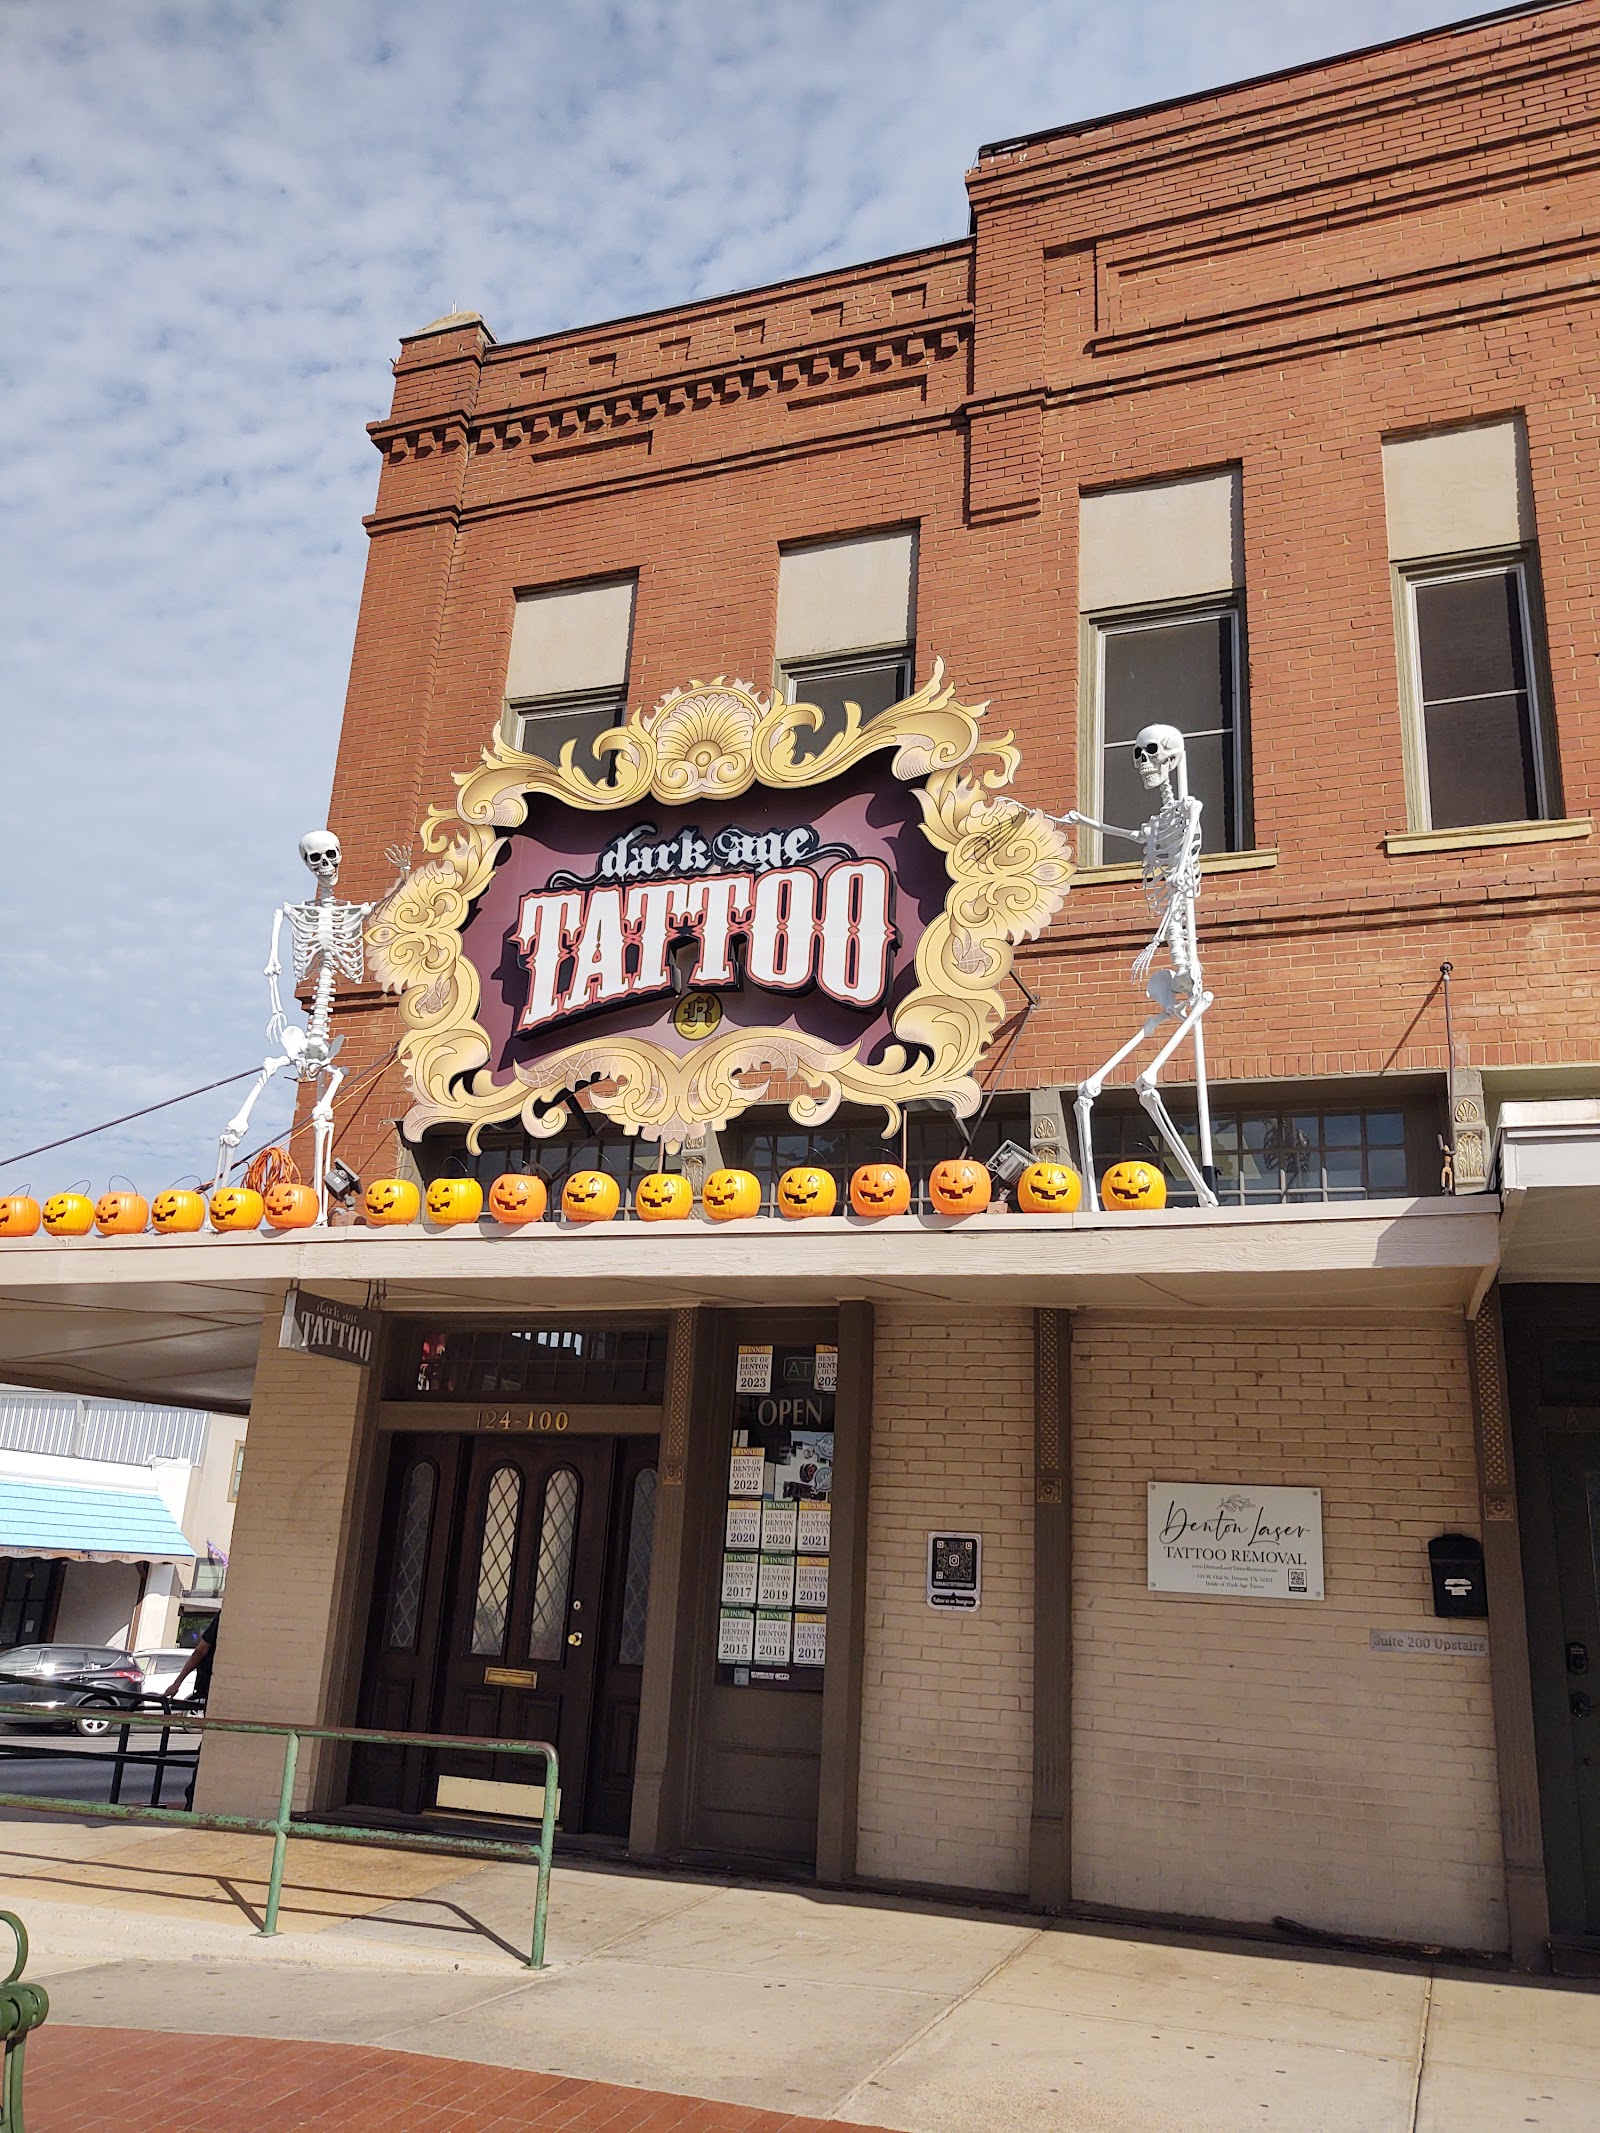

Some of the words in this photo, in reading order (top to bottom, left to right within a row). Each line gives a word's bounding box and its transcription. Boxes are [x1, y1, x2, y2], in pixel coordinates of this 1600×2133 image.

[601, 824, 708, 878] dark
[713, 826, 812, 871] age
[508, 857, 897, 1032] TATTOO
[301, 1311, 372, 1362] TATTOO
[787, 1361, 815, 1377] AT
[740, 1378, 766, 1387] 2023
[818, 1377, 837, 1386] 202
[758, 1399, 823, 1427] OPEN
[476, 1410, 569, 1431] 124-100
[734, 1480, 758, 1489] 2022
[1159, 1500, 1248, 1544] Denton
[1248, 1507, 1310, 1546] Laser
[730, 1533, 755, 1542] 2020
[766, 1534, 790, 1544] 2020
[802, 1535, 827, 1545] 2021
[1164, 1546, 1227, 1561] TATTOO
[1232, 1551, 1307, 1565] REMOVAL
[726, 1587, 751, 1597] 2017
[763, 1589, 788, 1600] 2019
[800, 1590, 825, 1601] 2019
[760, 1612, 789, 1620] WINNER
[722, 1628, 750, 1636] DENTON
[723, 1643, 747, 1654] 2015
[1374, 1636, 1403, 1646] Suite
[1408, 1637, 1430, 1648] 200
[1434, 1638, 1485, 1652] Upstairs
[760, 1645, 785, 1656] 2016
[798, 1648, 824, 1658] 2017
